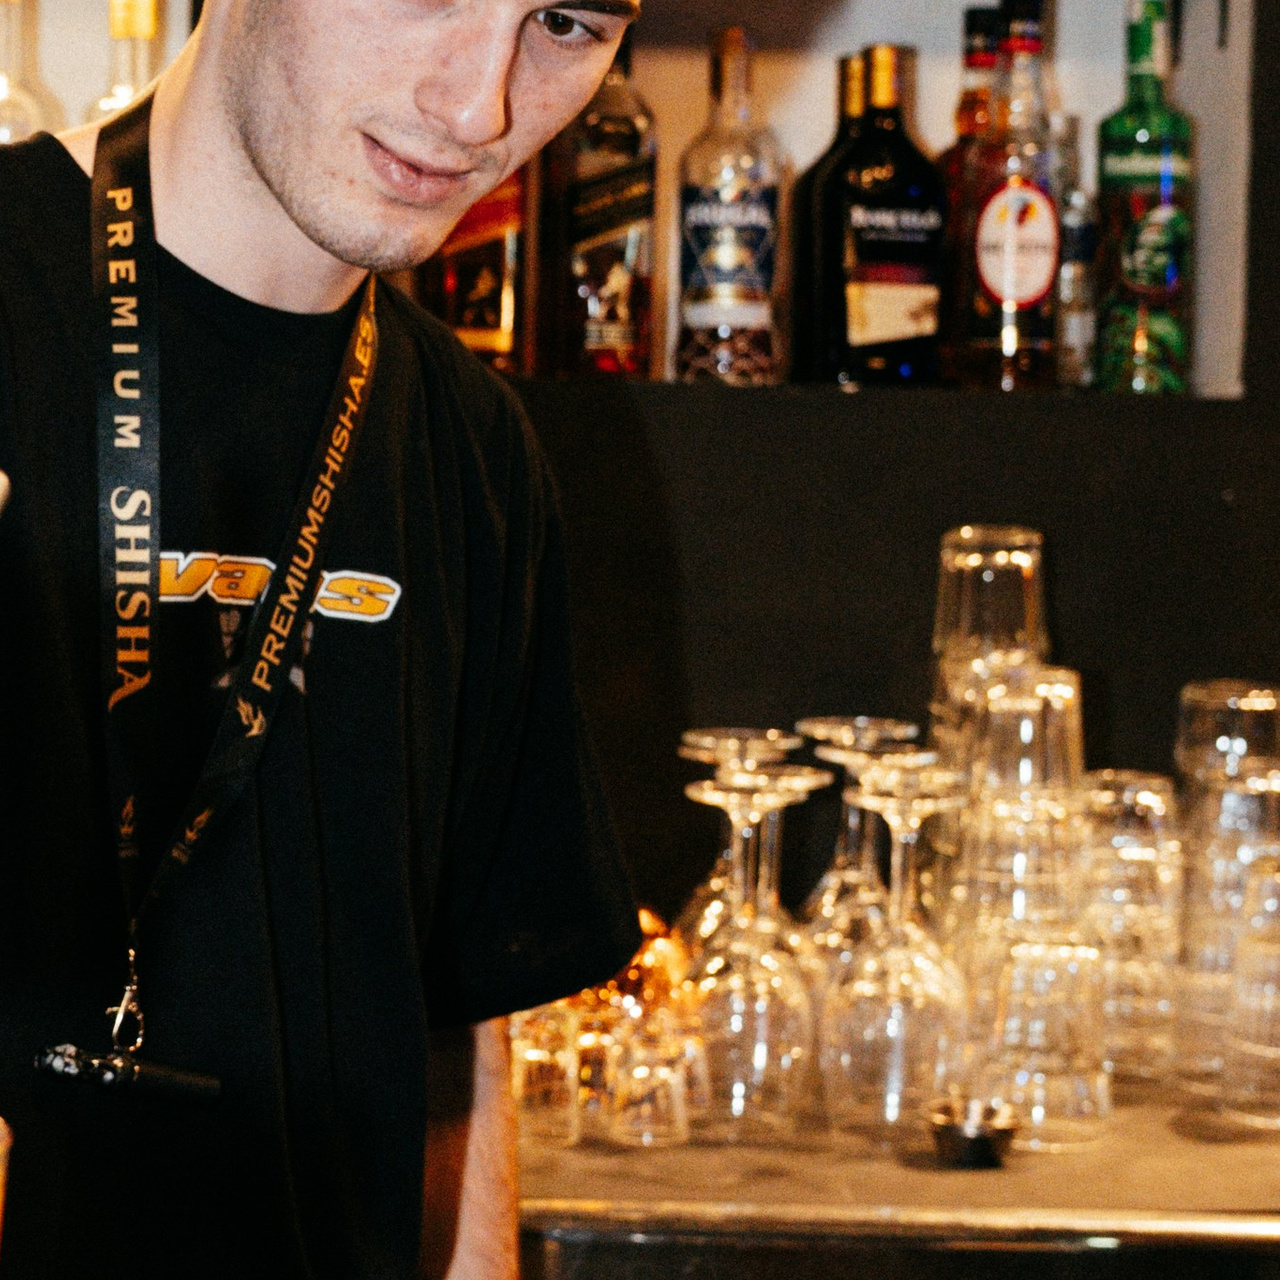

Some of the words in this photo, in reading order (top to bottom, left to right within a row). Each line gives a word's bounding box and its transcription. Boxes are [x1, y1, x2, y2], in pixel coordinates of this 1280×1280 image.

[106, 186, 142, 449] PREMIUM
[108, 485, 152, 713] SHISHA
[158, 551, 402, 622] vas
[251, 313, 377, 692] PREMIUMSHISHA.ES
